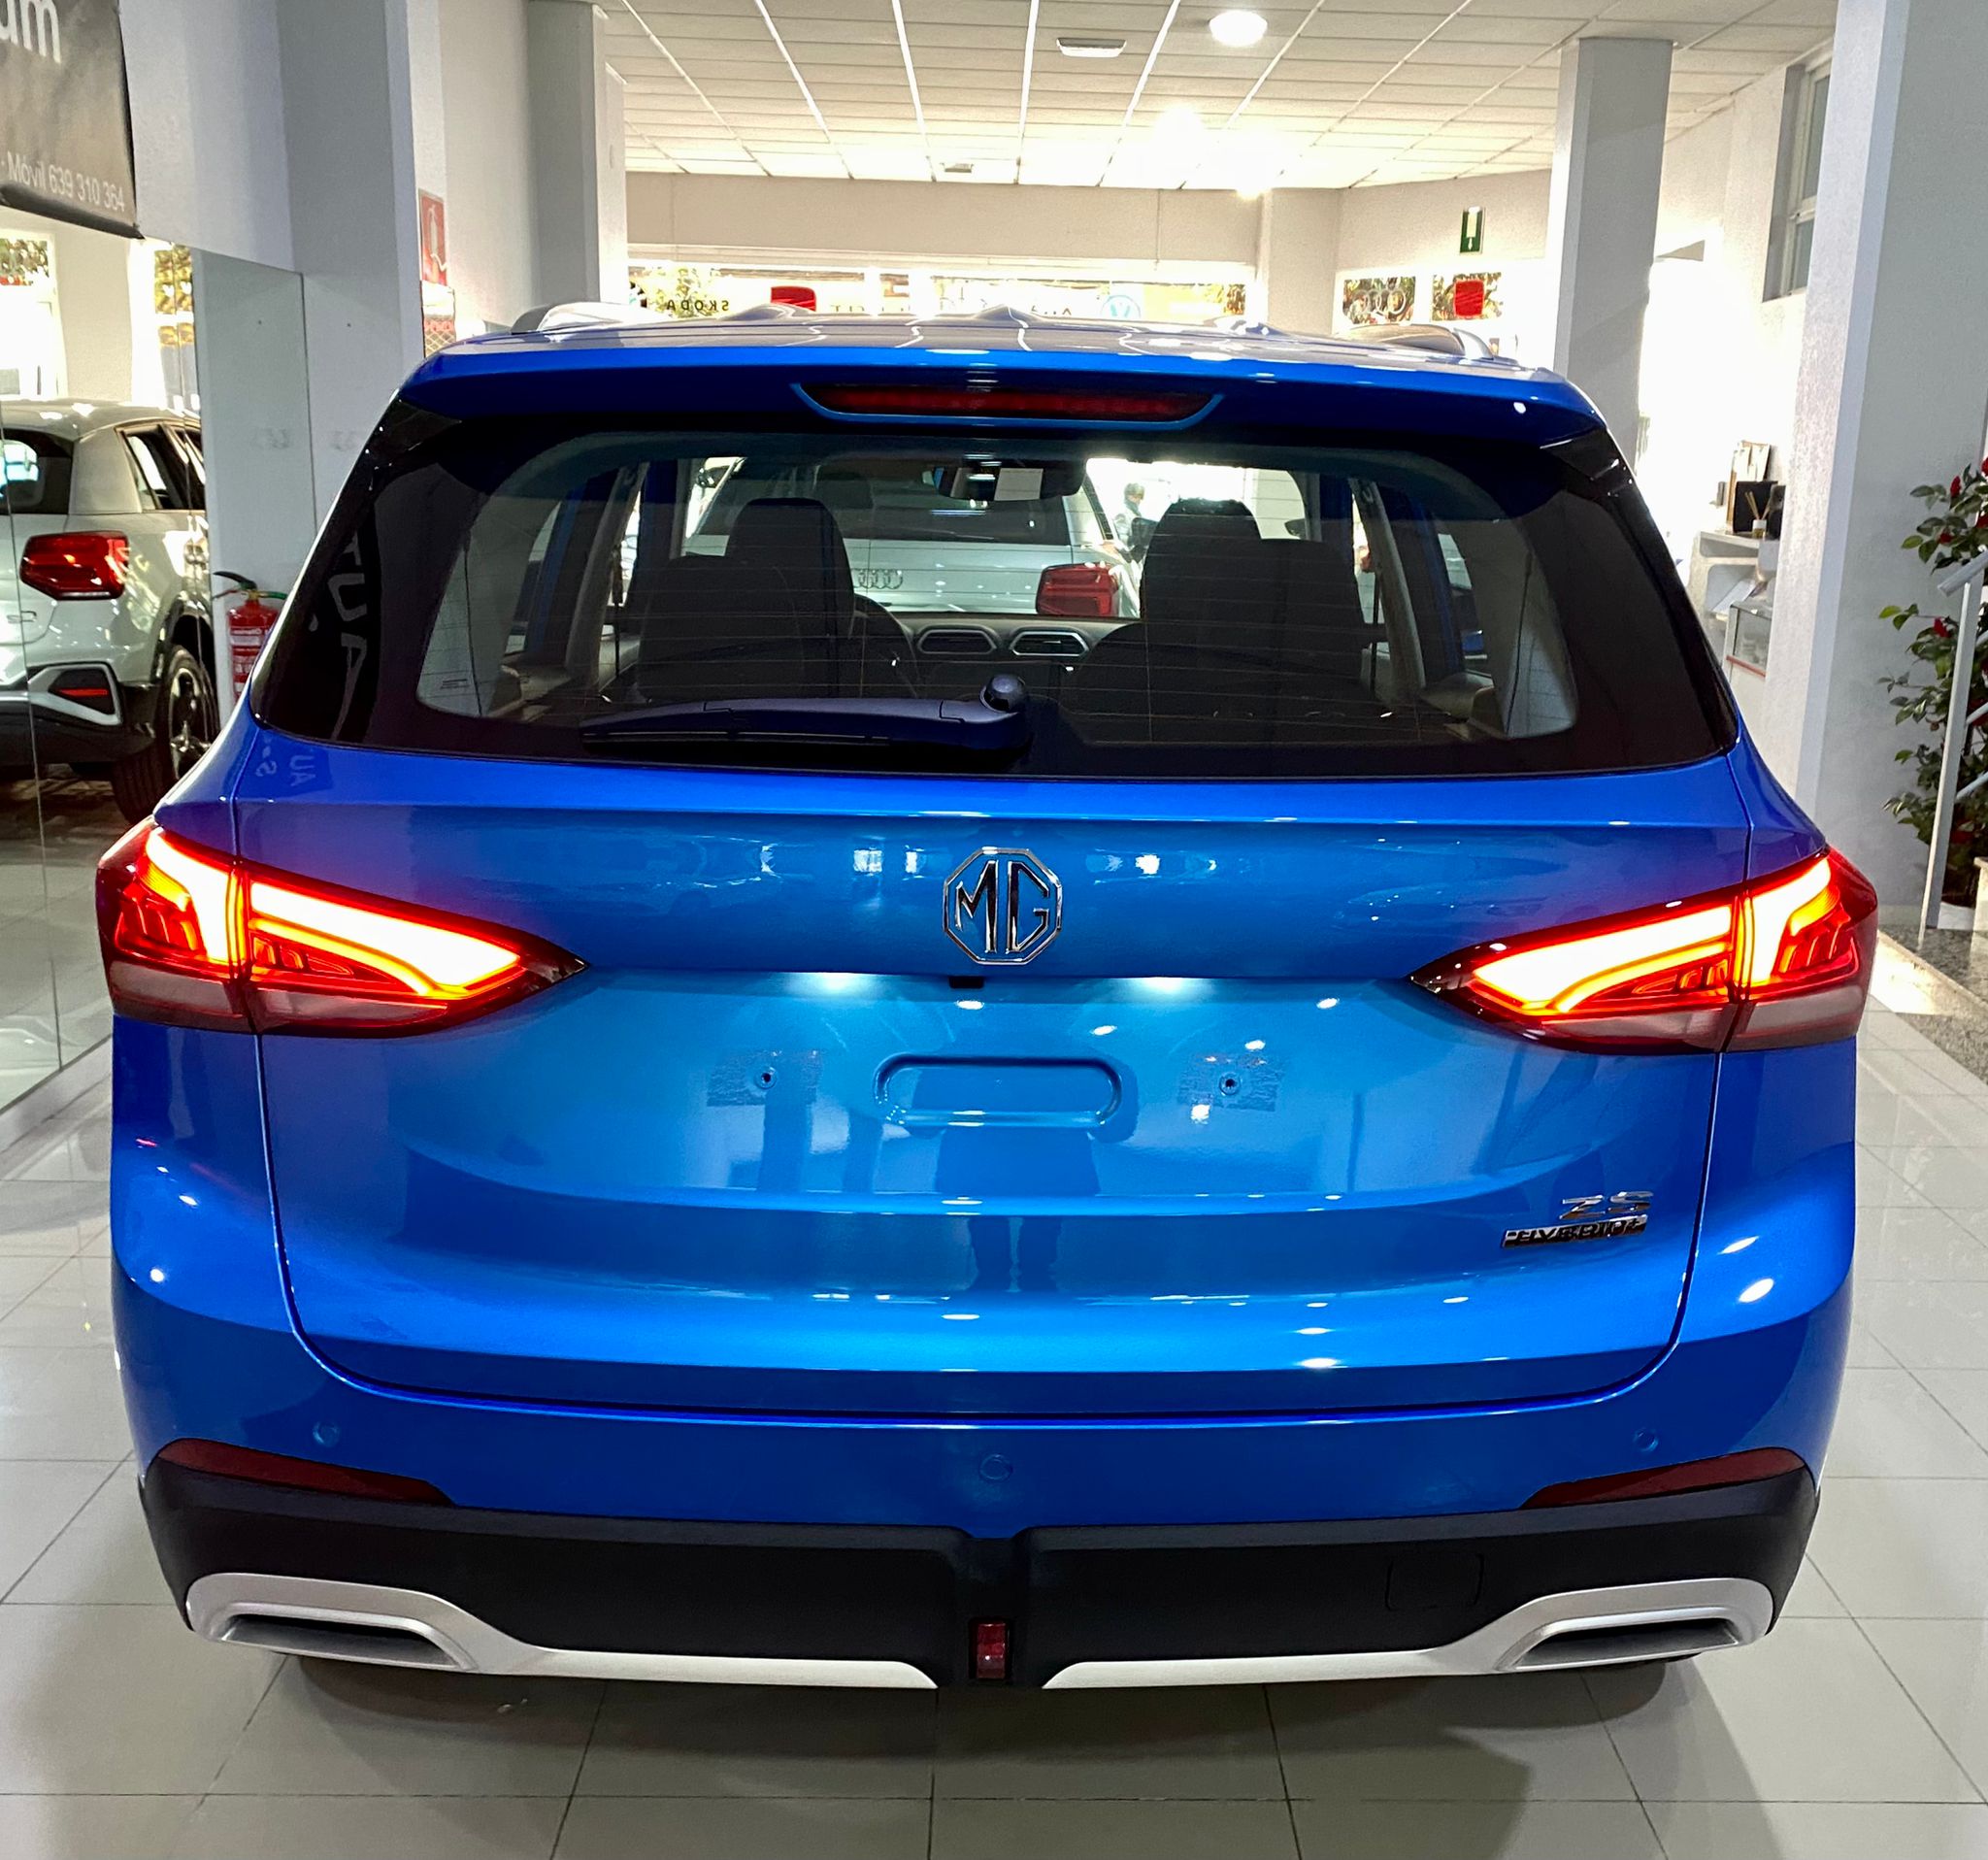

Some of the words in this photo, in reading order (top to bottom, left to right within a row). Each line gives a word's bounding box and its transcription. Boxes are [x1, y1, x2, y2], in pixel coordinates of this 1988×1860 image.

[8, 150, 47, 189] Móvil
[49, 164, 74, 199] 639
[77, 173, 100, 206] 310
[103, 181, 125, 213] 364
[955, 860, 1049, 954] MG
[1559, 1191, 1654, 1220] ZS
